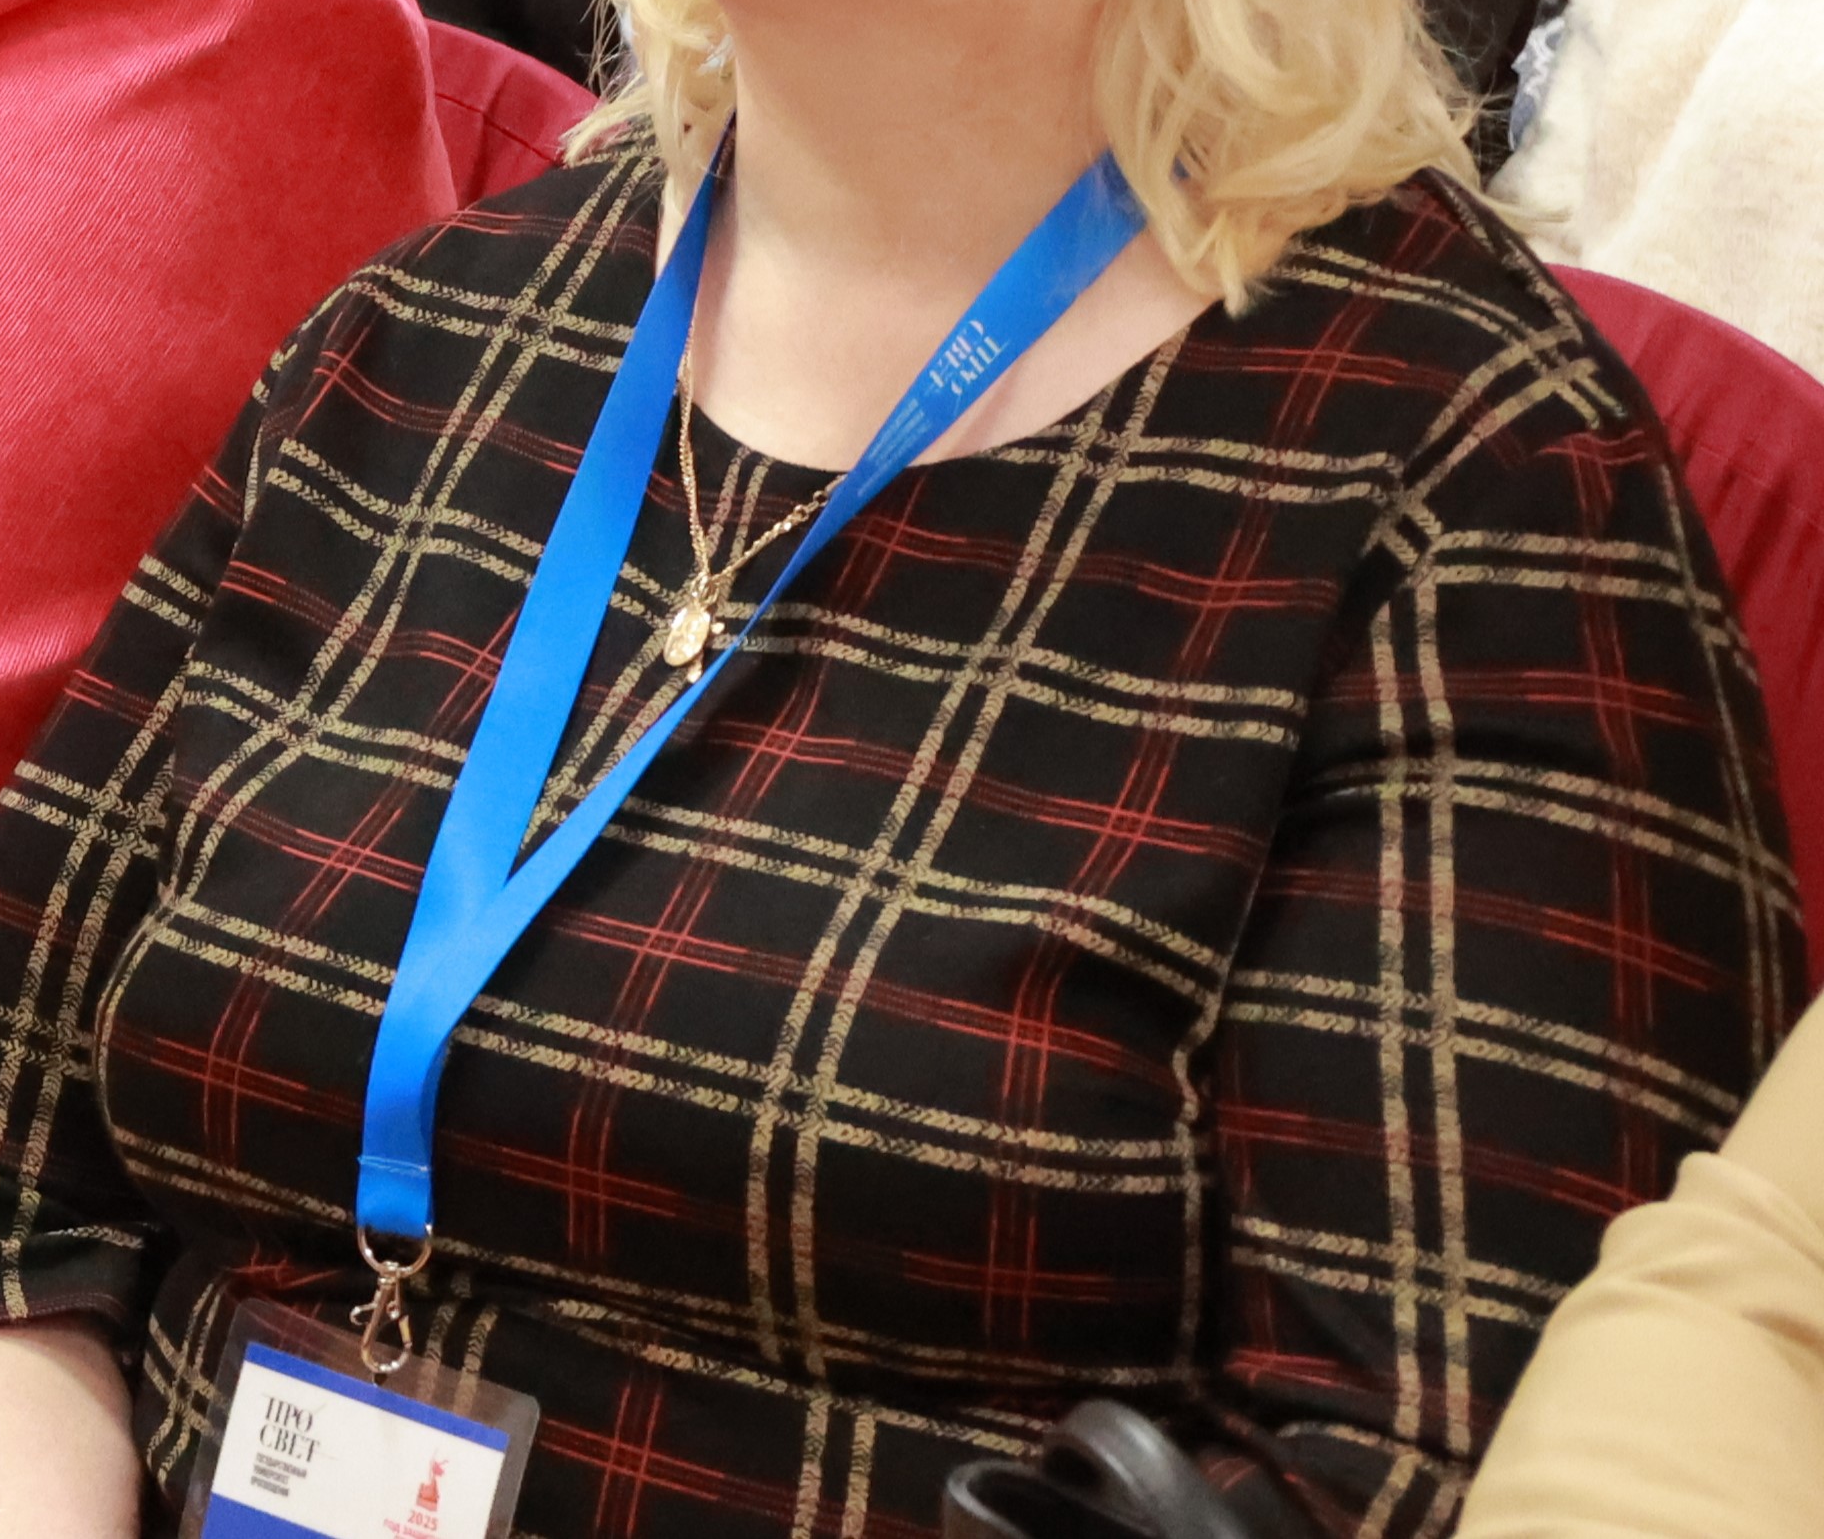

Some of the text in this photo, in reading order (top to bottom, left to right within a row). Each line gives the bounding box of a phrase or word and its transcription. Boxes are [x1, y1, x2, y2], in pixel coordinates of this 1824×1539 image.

[264, 1396, 314, 1434] ПРО
[259, 1424, 321, 1463] СВЕТ
[407, 1510, 439, 1532] 2025
